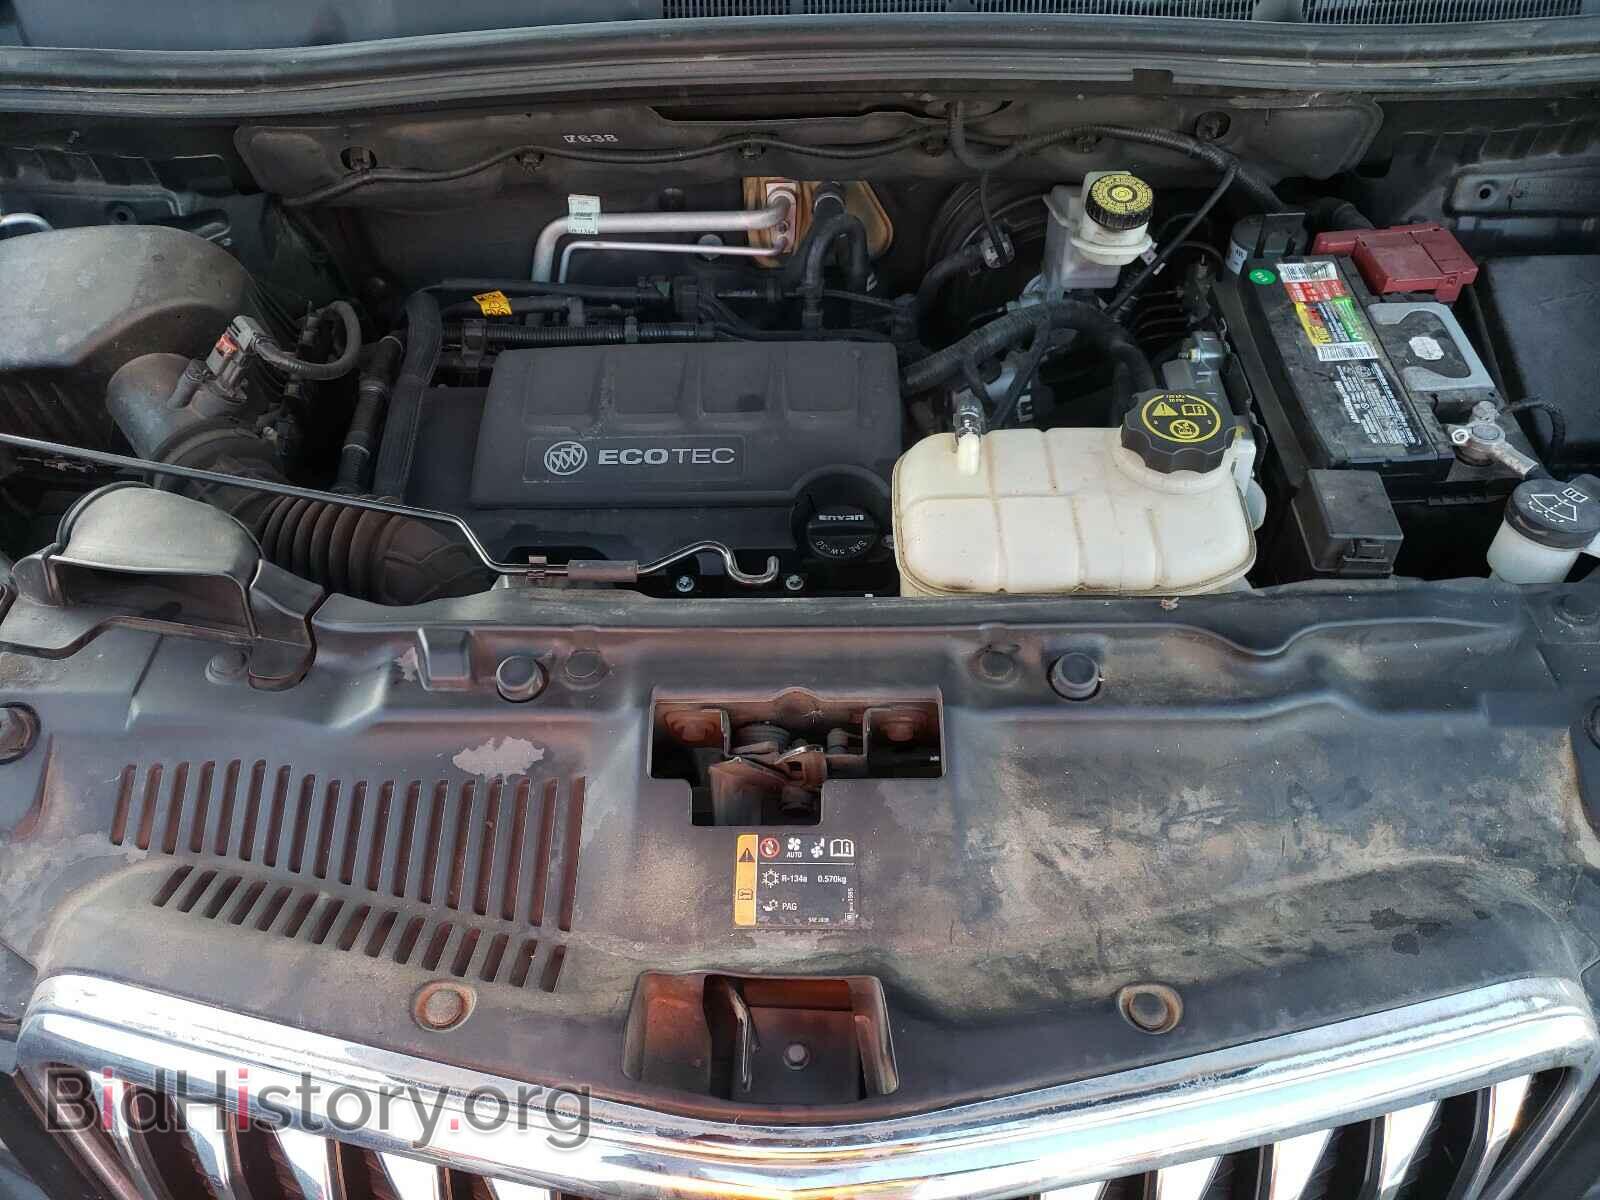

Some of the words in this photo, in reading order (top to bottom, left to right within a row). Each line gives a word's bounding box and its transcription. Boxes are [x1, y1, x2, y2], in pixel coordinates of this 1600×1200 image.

[598, 448, 736, 466] ECOTEC
[781, 874, 808, 883] R-134a
[817, 874, 847, 885] 0.570kg
[782, 902, 798, 911] PAG
